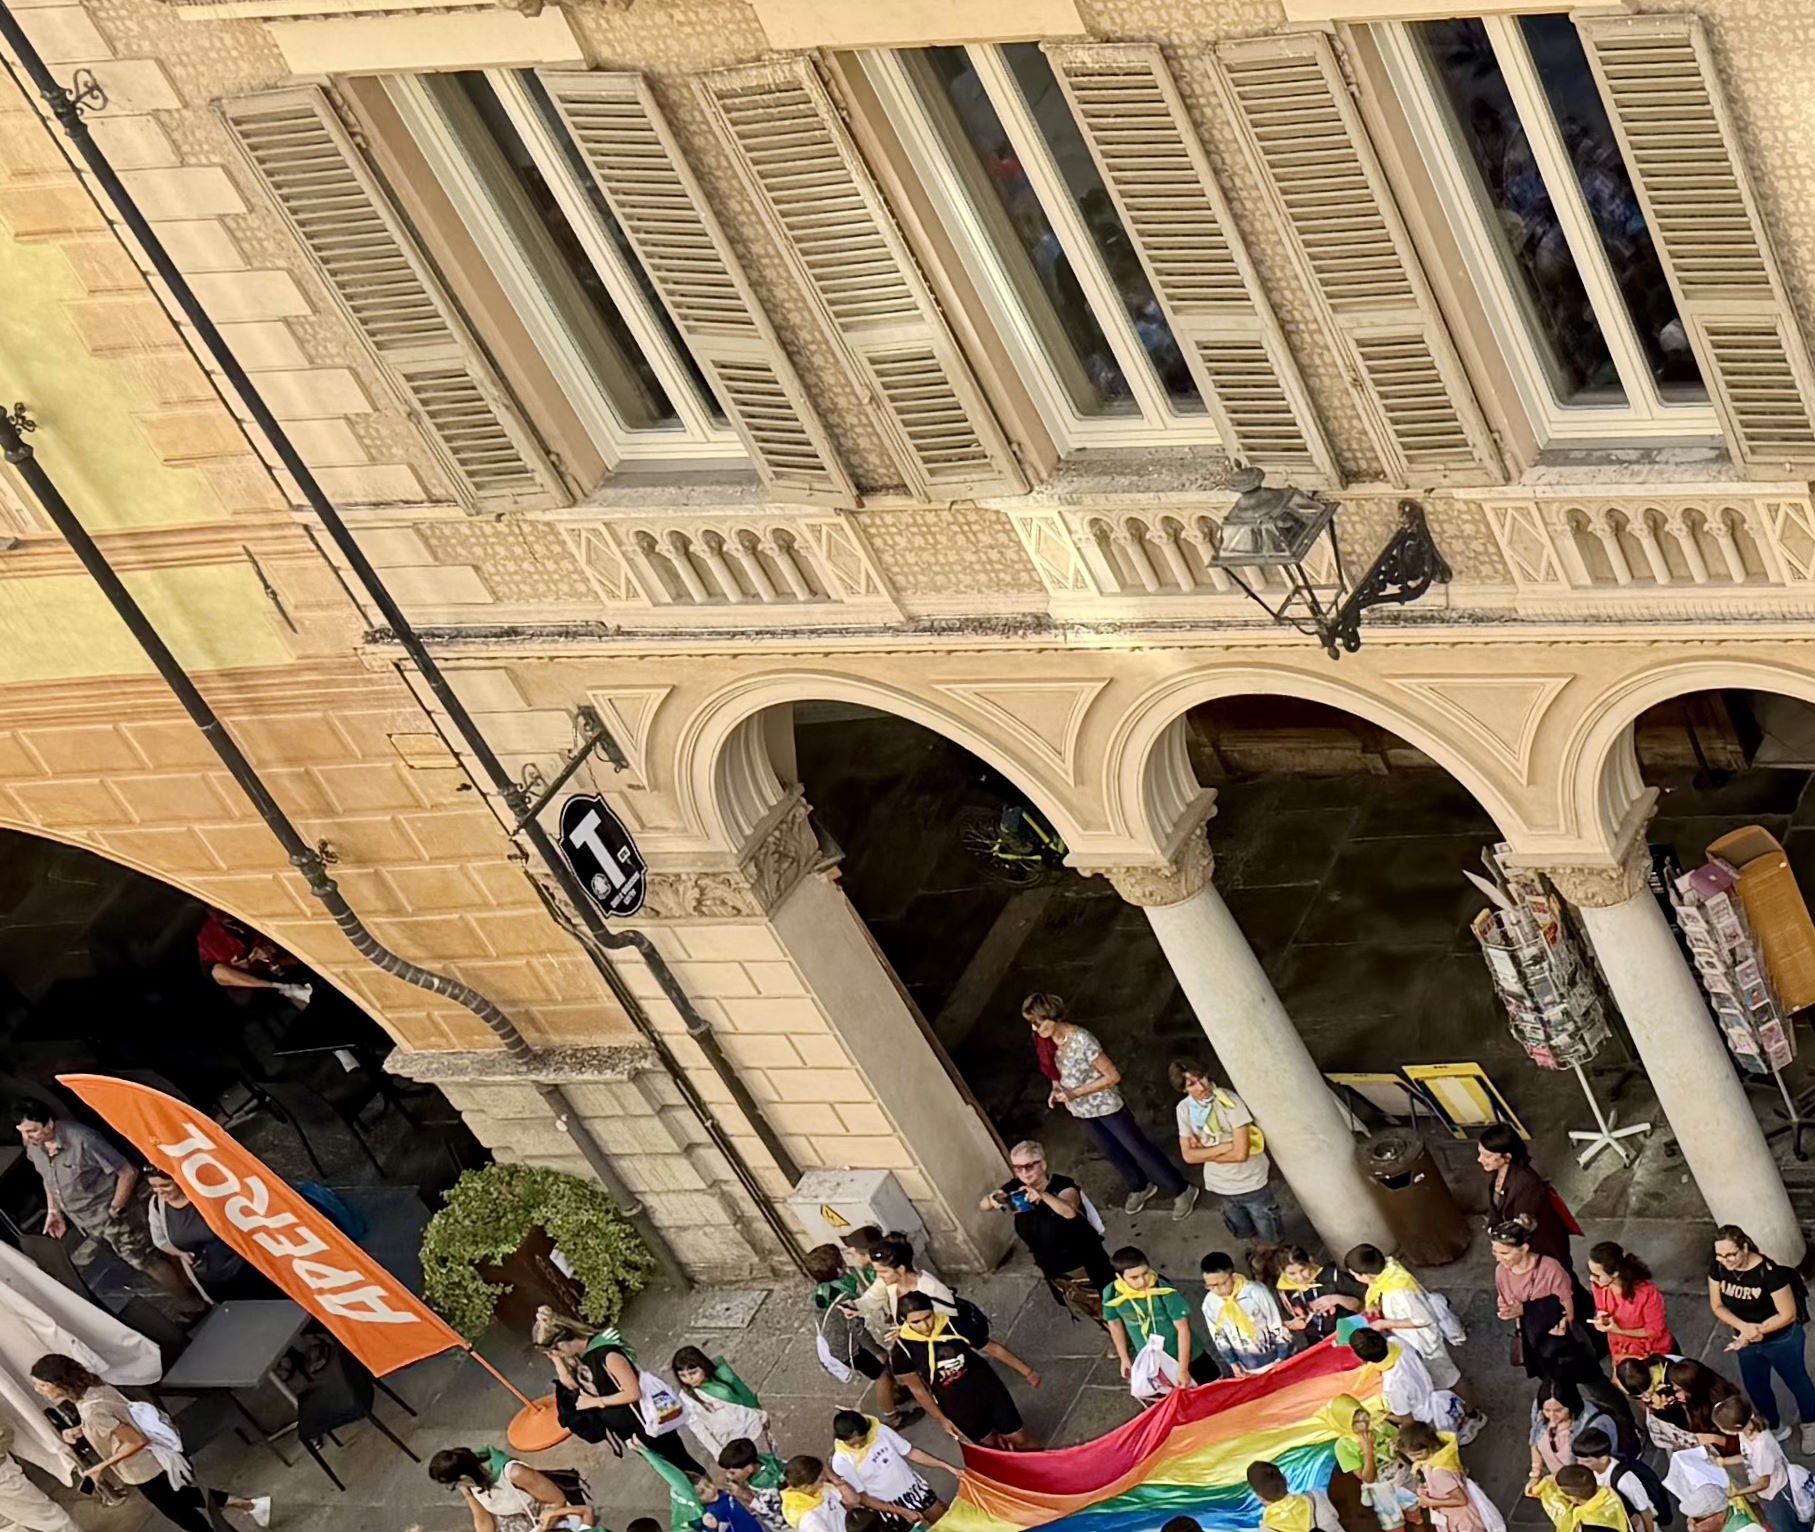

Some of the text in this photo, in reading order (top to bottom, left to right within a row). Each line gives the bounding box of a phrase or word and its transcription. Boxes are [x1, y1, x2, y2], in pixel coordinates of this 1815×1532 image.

[568, 808, 626, 889] T
[157, 1122, 421, 1323] APEROL
[1720, 1280, 1753, 1300] AMOR
